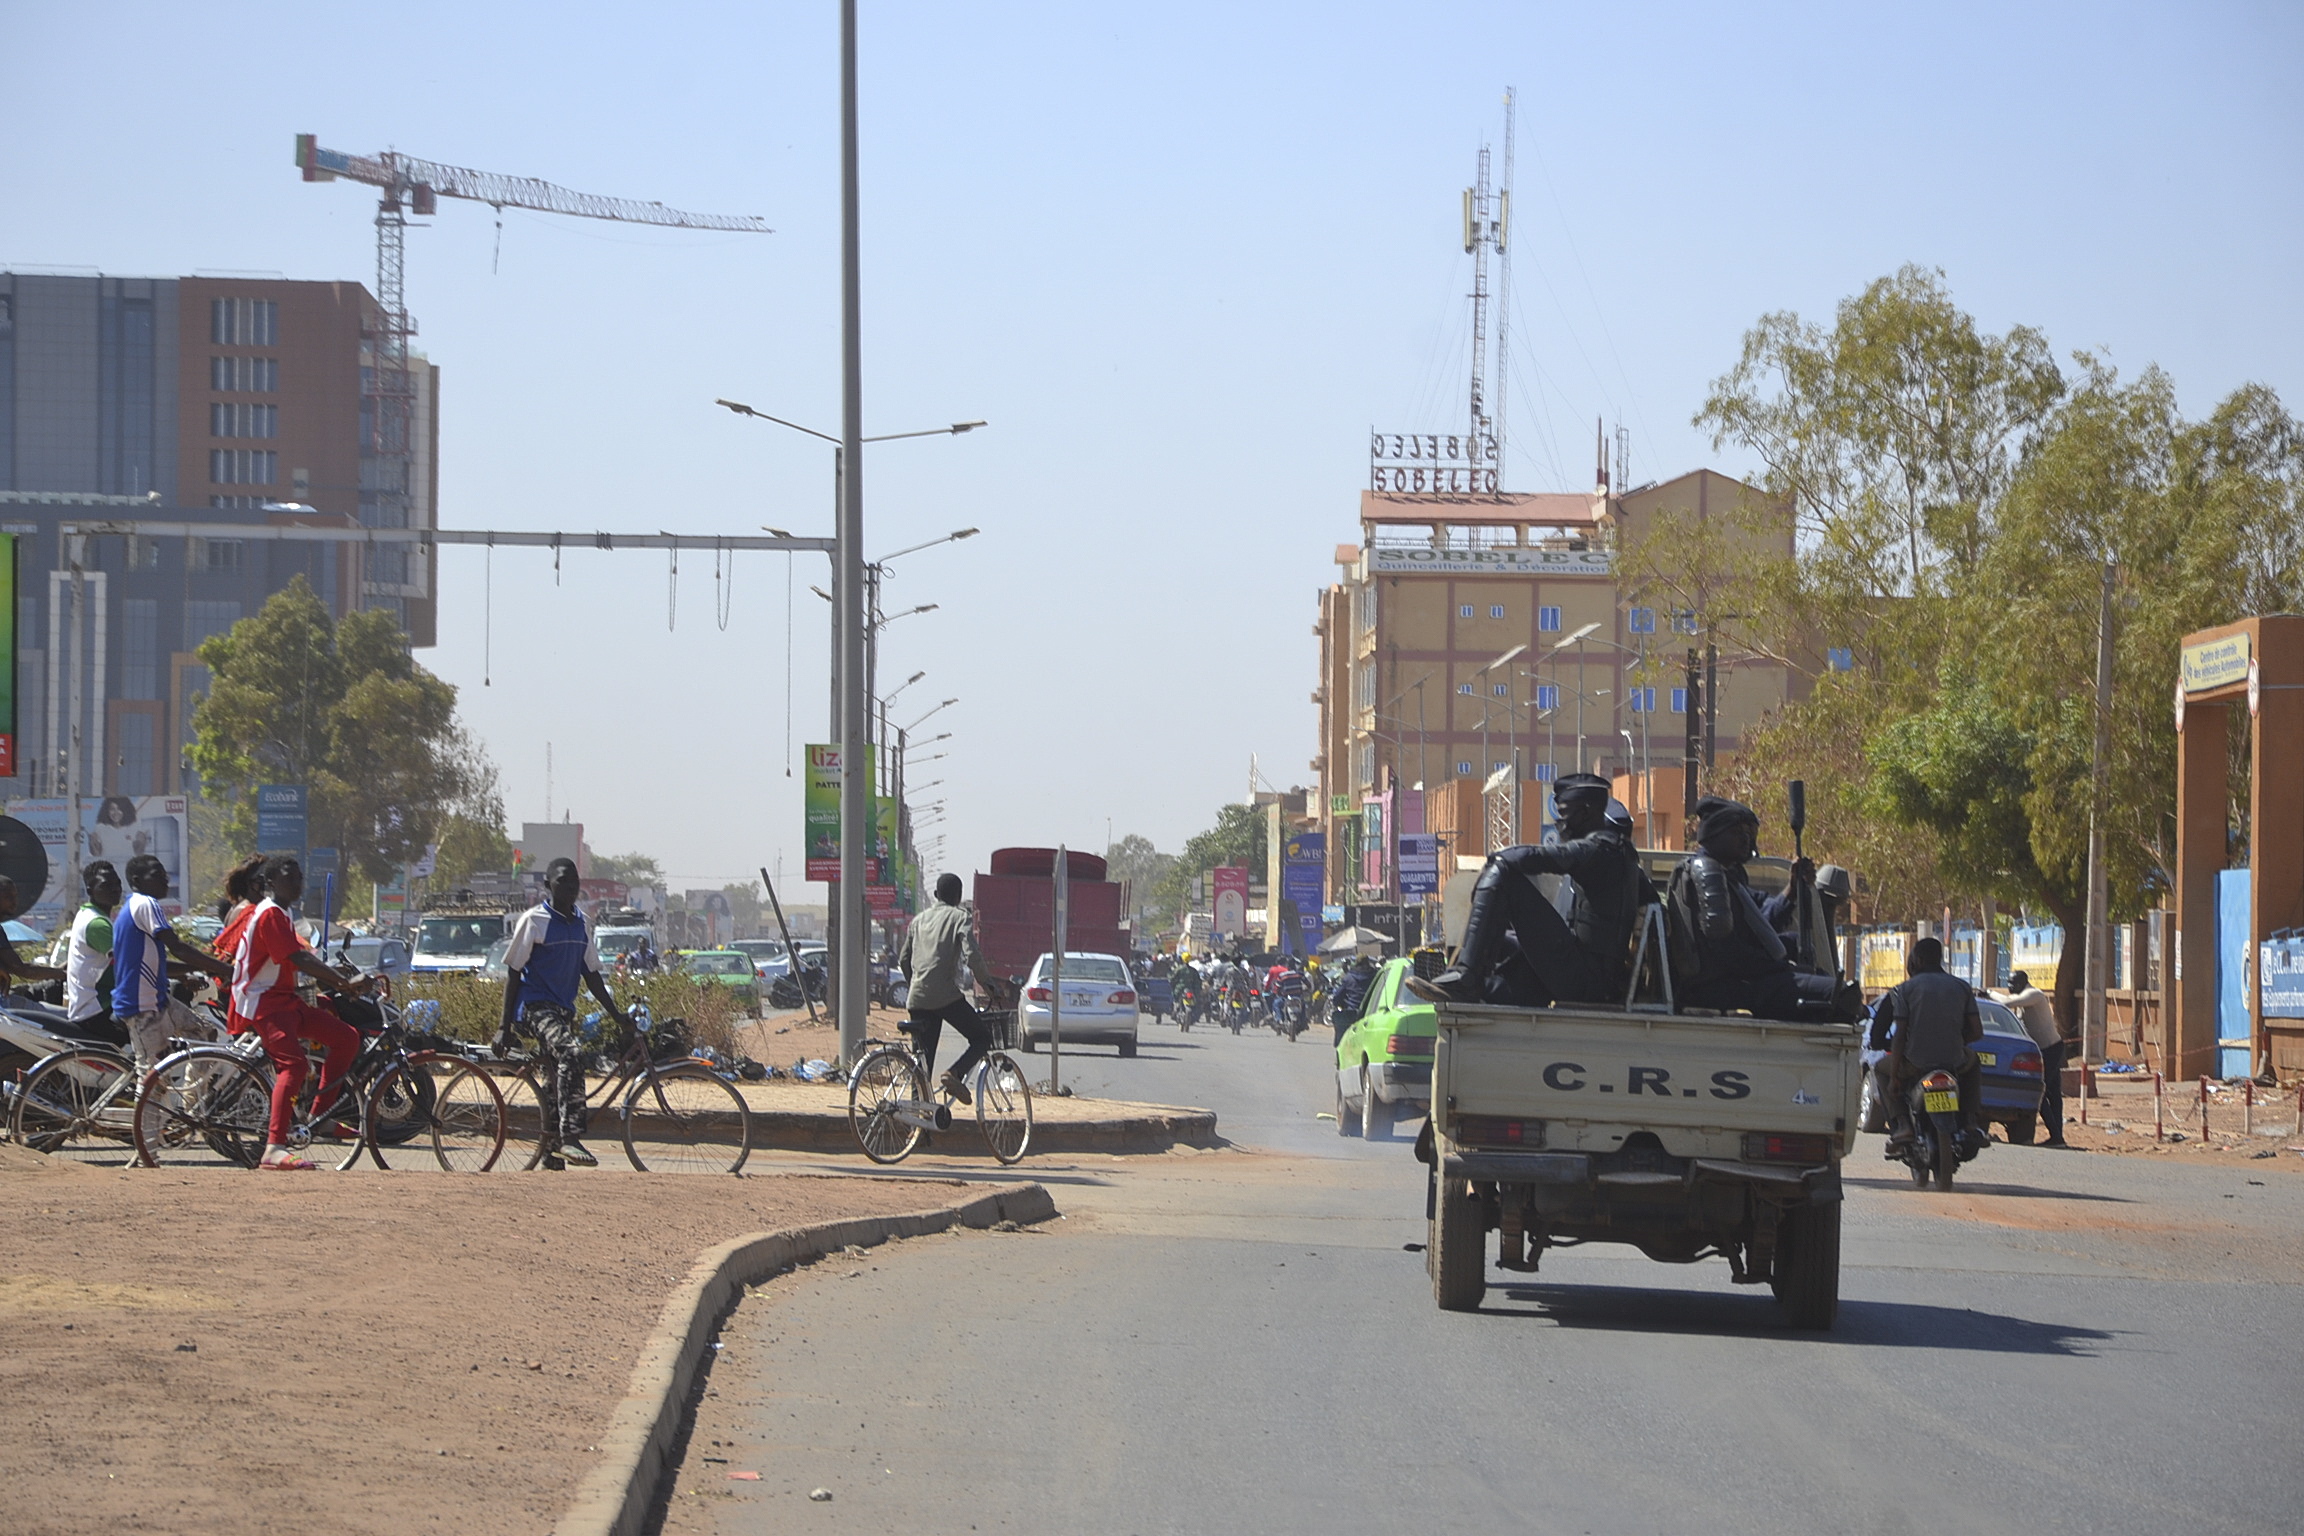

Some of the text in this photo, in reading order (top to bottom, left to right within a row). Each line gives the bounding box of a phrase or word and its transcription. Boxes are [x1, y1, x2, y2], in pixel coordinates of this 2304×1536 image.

[1374, 466, 1498, 494] SOBELEC
[1377, 562, 1484, 572] Quincaillerie
[1495, 563, 1507, 571] &
[2200, 650, 2214, 664] Centre
